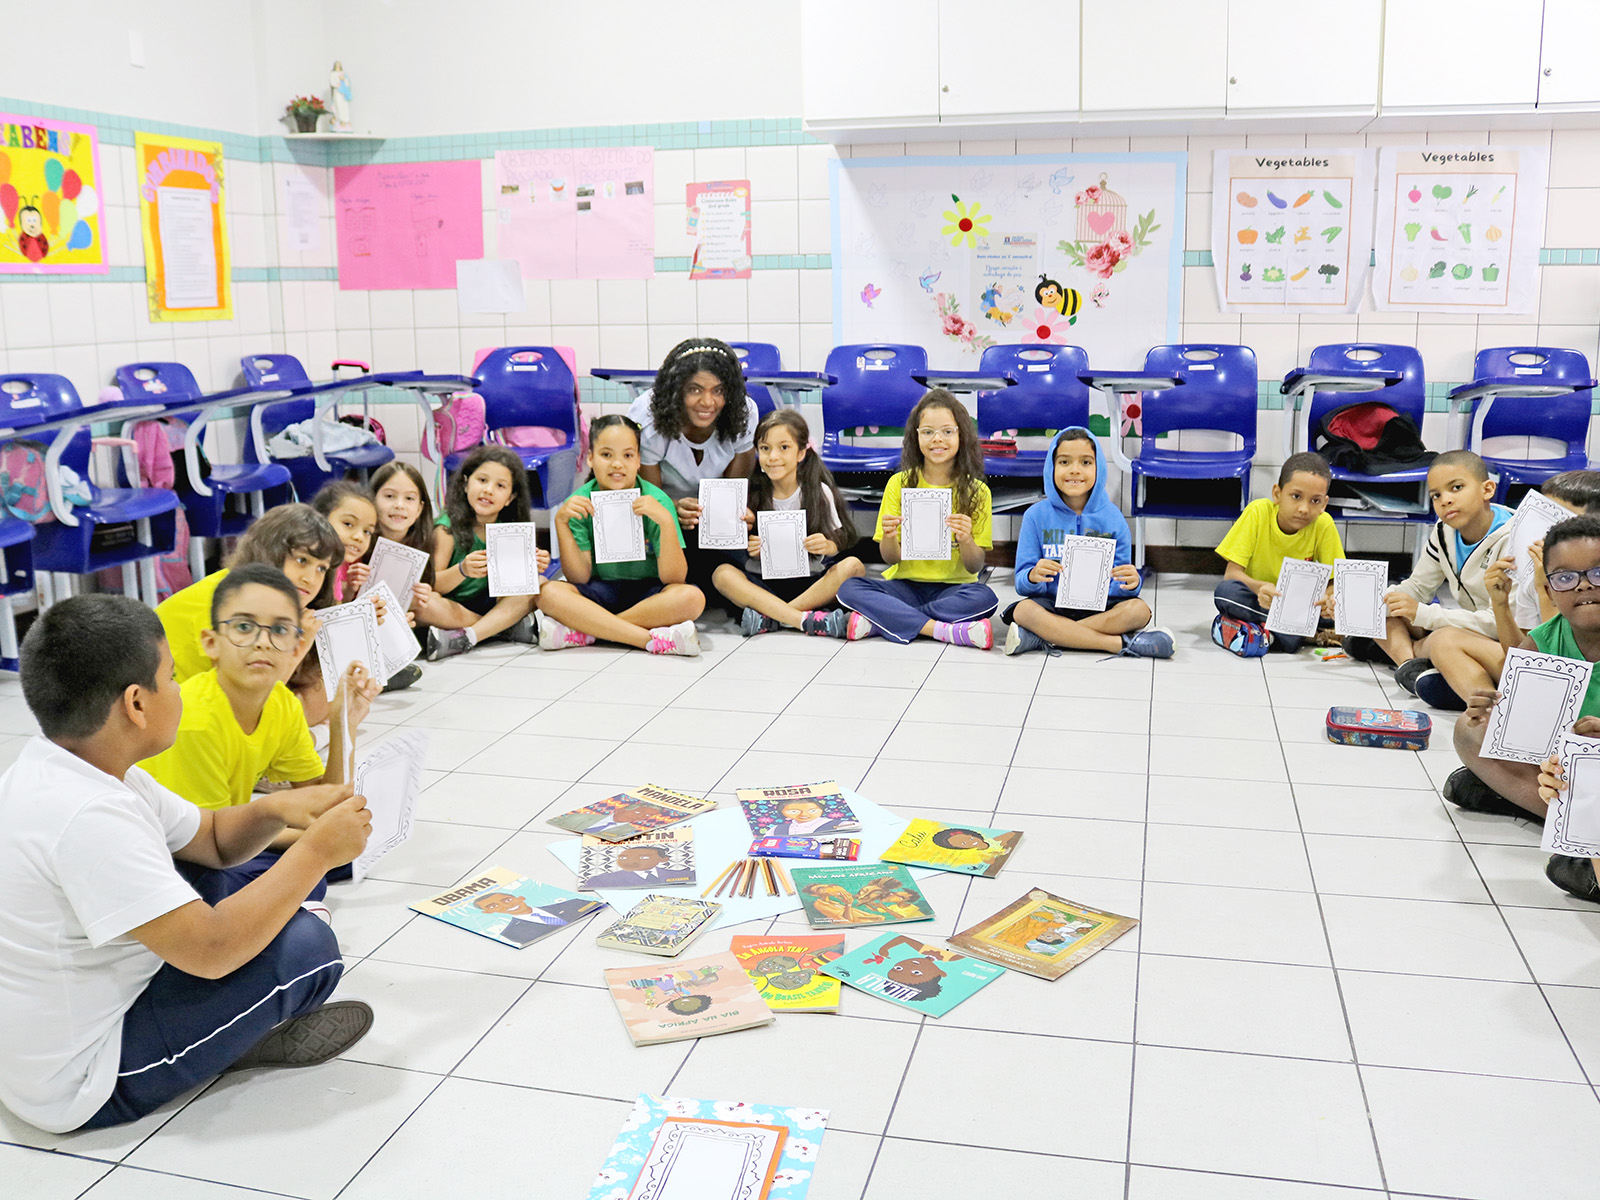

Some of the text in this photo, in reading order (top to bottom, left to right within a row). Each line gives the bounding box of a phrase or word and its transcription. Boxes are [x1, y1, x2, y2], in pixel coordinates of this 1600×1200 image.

[1255, 156, 1329, 170] Vegetables
[1421, 151, 1495, 165] Vegetables
[507, 169, 553, 183] PASSADO
[580, 167, 638, 184] PRESENTE
[1042, 544, 1064, 558] TAR
[637, 787, 705, 810] MANDELA
[763, 787, 812, 797] ROSA
[431, 877, 497, 906] OBAMA
[855, 974, 918, 1002] BUCALA
[719, 1010, 740, 1018] BIA
